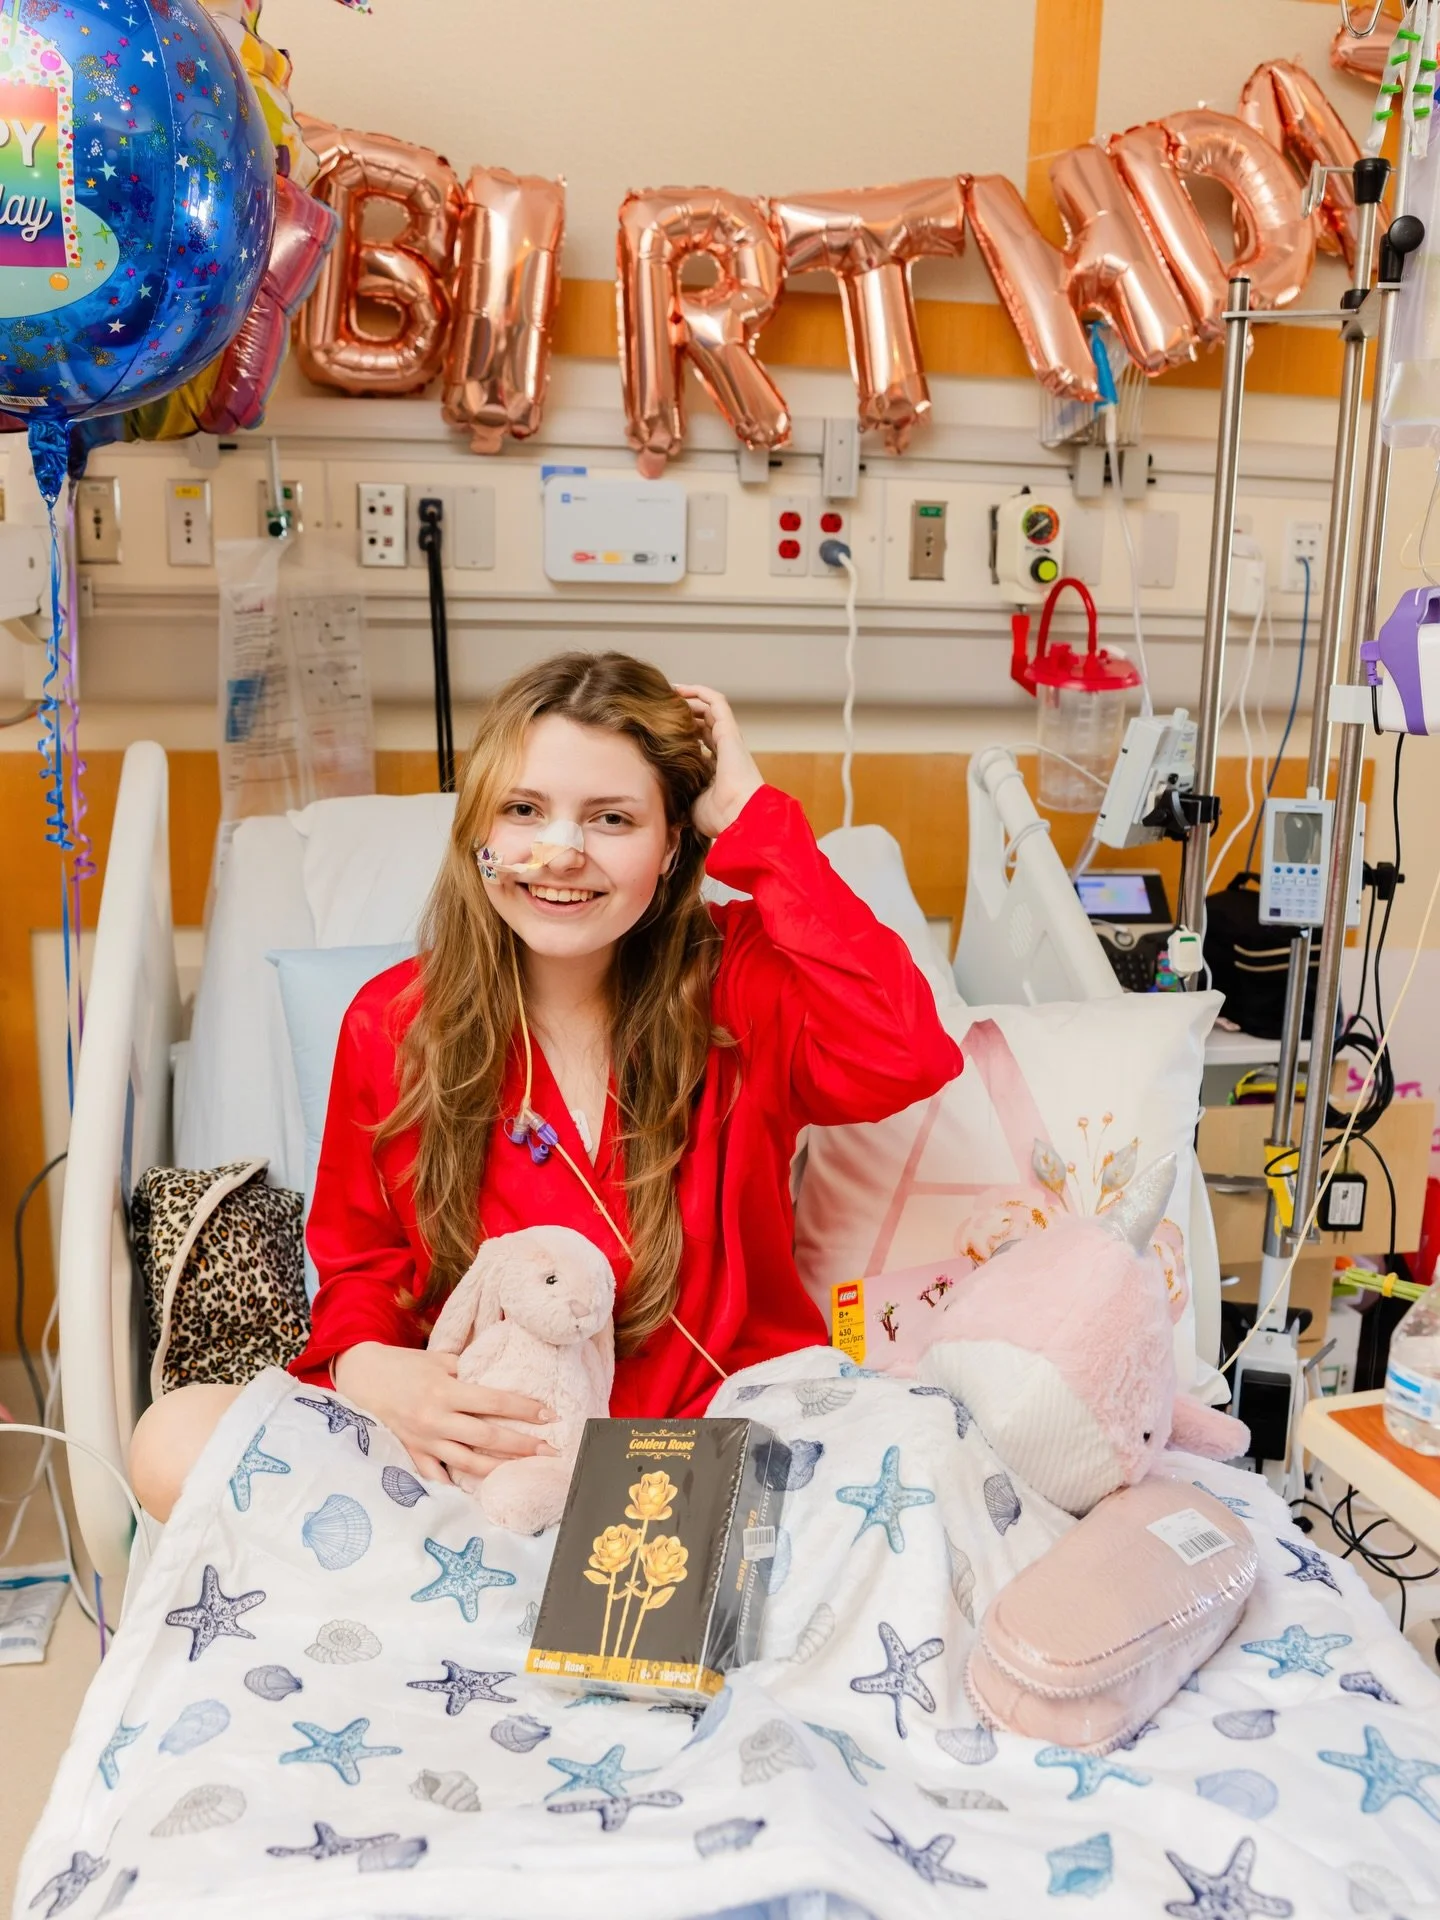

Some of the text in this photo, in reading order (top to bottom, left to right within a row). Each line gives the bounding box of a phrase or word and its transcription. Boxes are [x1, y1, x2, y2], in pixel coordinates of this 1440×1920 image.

[839, 1328, 852, 1336] 430
[629, 1438, 695, 1451] Golden Rose
[757, 1480, 774, 1528] Luxur
[738, 1557, 761, 1637] dmiration
[533, 1657, 586, 1673] Golden Rose
